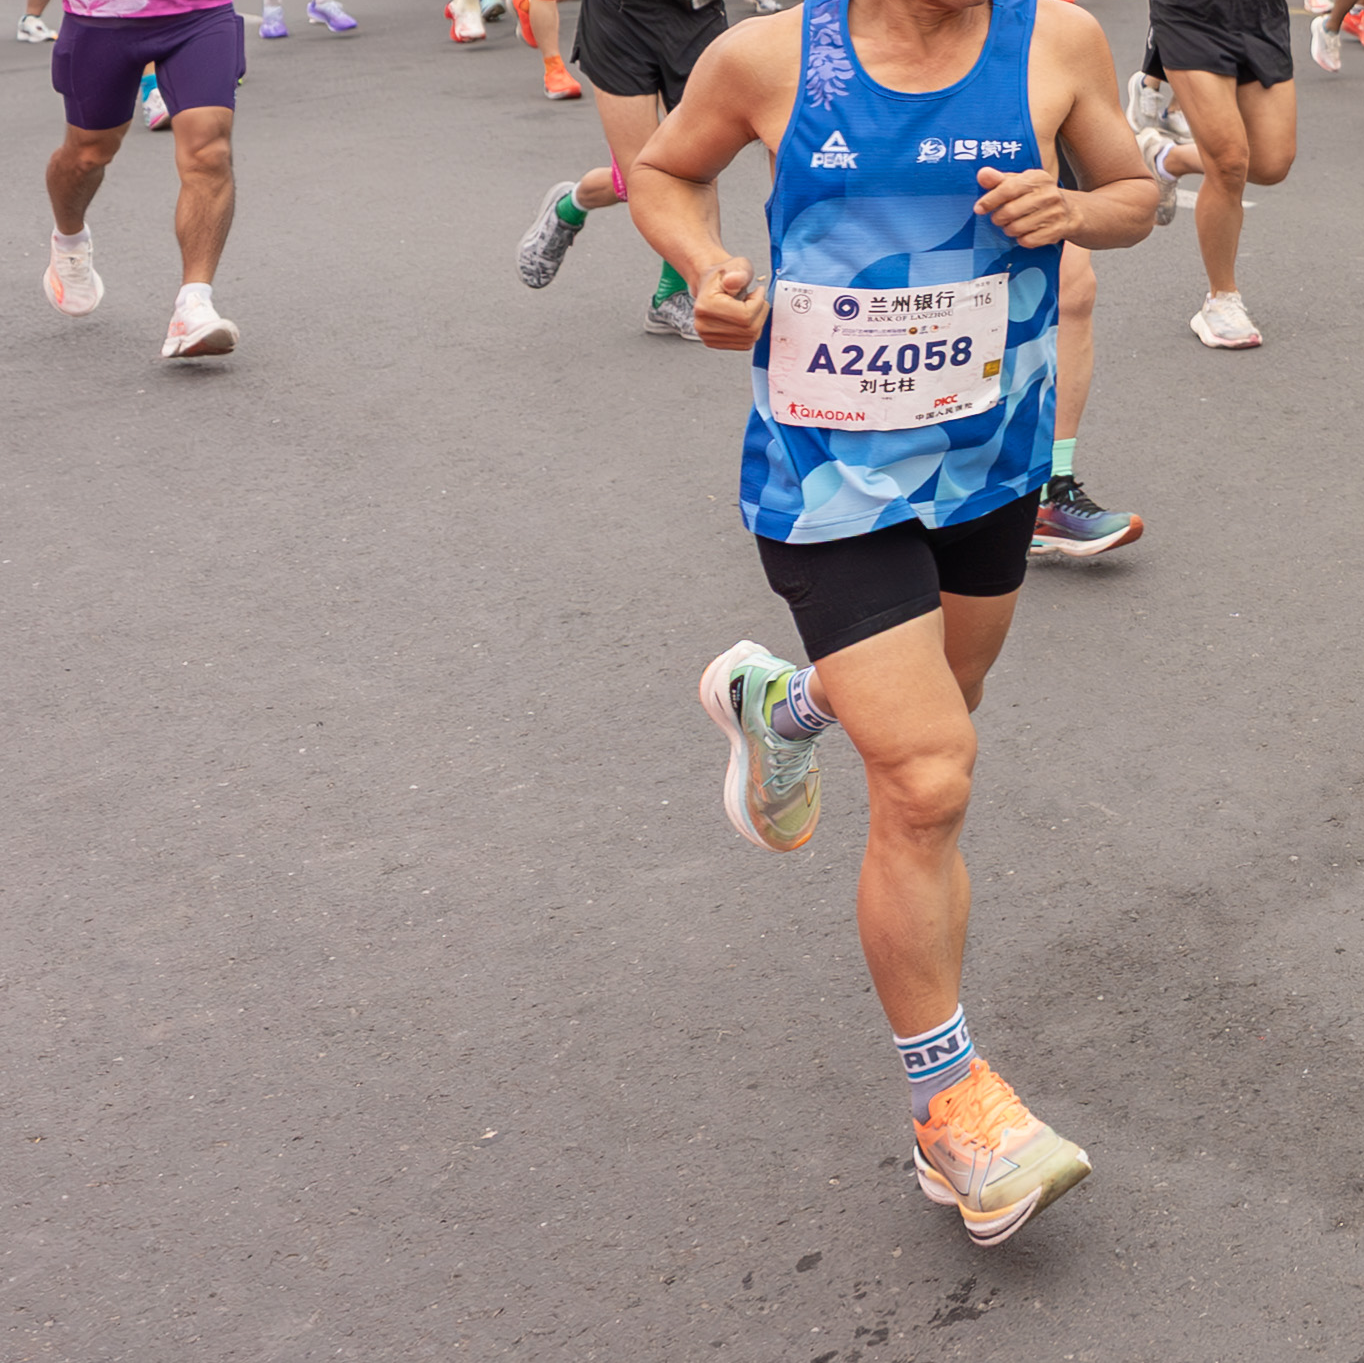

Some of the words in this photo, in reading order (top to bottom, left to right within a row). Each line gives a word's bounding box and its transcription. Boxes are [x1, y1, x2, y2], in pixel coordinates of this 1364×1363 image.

[980, 140, 1022, 160] 蒙牛
[810, 151, 859, 169] PEAK
[792, 299, 809, 310] 43
[868, 291, 956, 314] 兰州银行
[973, 292, 992, 307] 116
[867, 314, 894, 323] BANK
[895, 314, 907, 322] OF
[910, 310, 954, 321] LANZHOU
[806, 335, 973, 376] A24058
[859, 377, 916, 394] 刘七柱
[934, 393, 959, 408] PICC
[800, 407, 866, 422] QIAODAN
